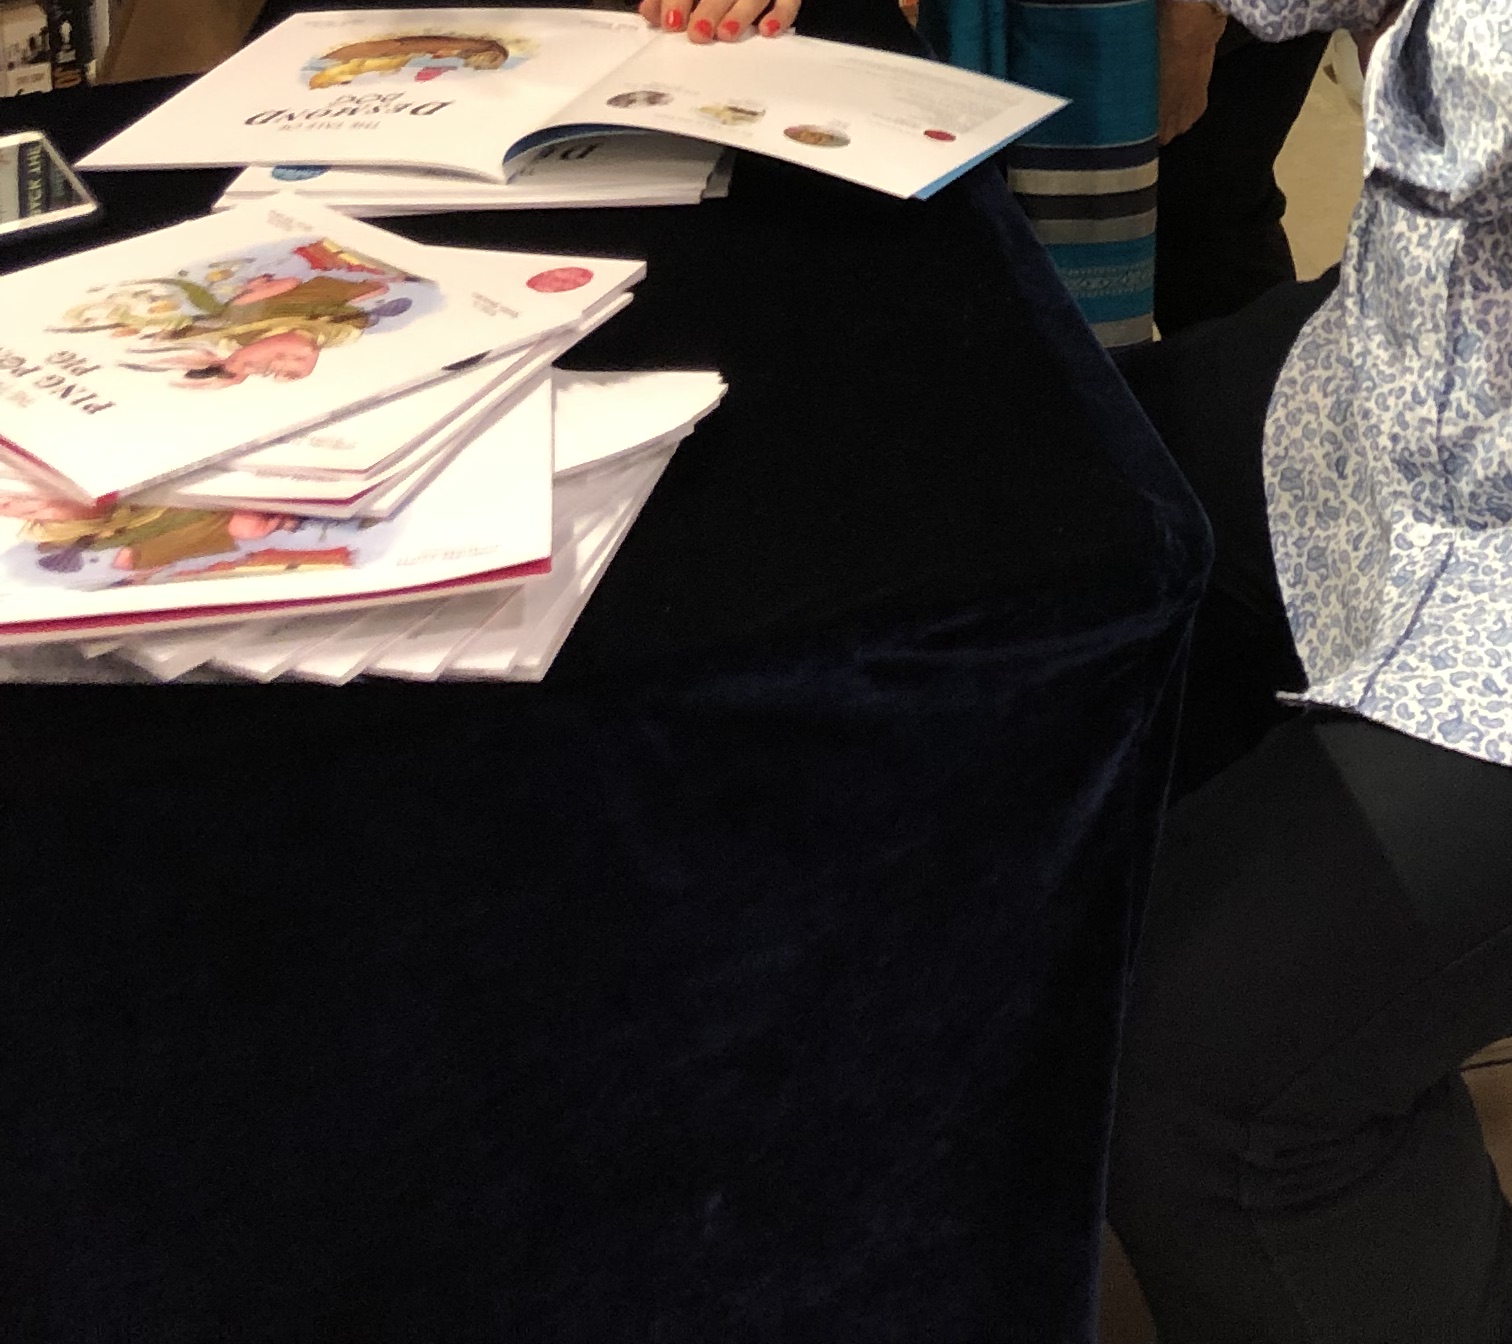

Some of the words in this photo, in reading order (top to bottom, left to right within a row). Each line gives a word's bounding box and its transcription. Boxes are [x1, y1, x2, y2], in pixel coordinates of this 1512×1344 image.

[329, 90, 405, 106] DOG
[245, 100, 454, 125] DESMOND
[44, 351, 100, 376] PIG
[33, 375, 115, 415] PING
